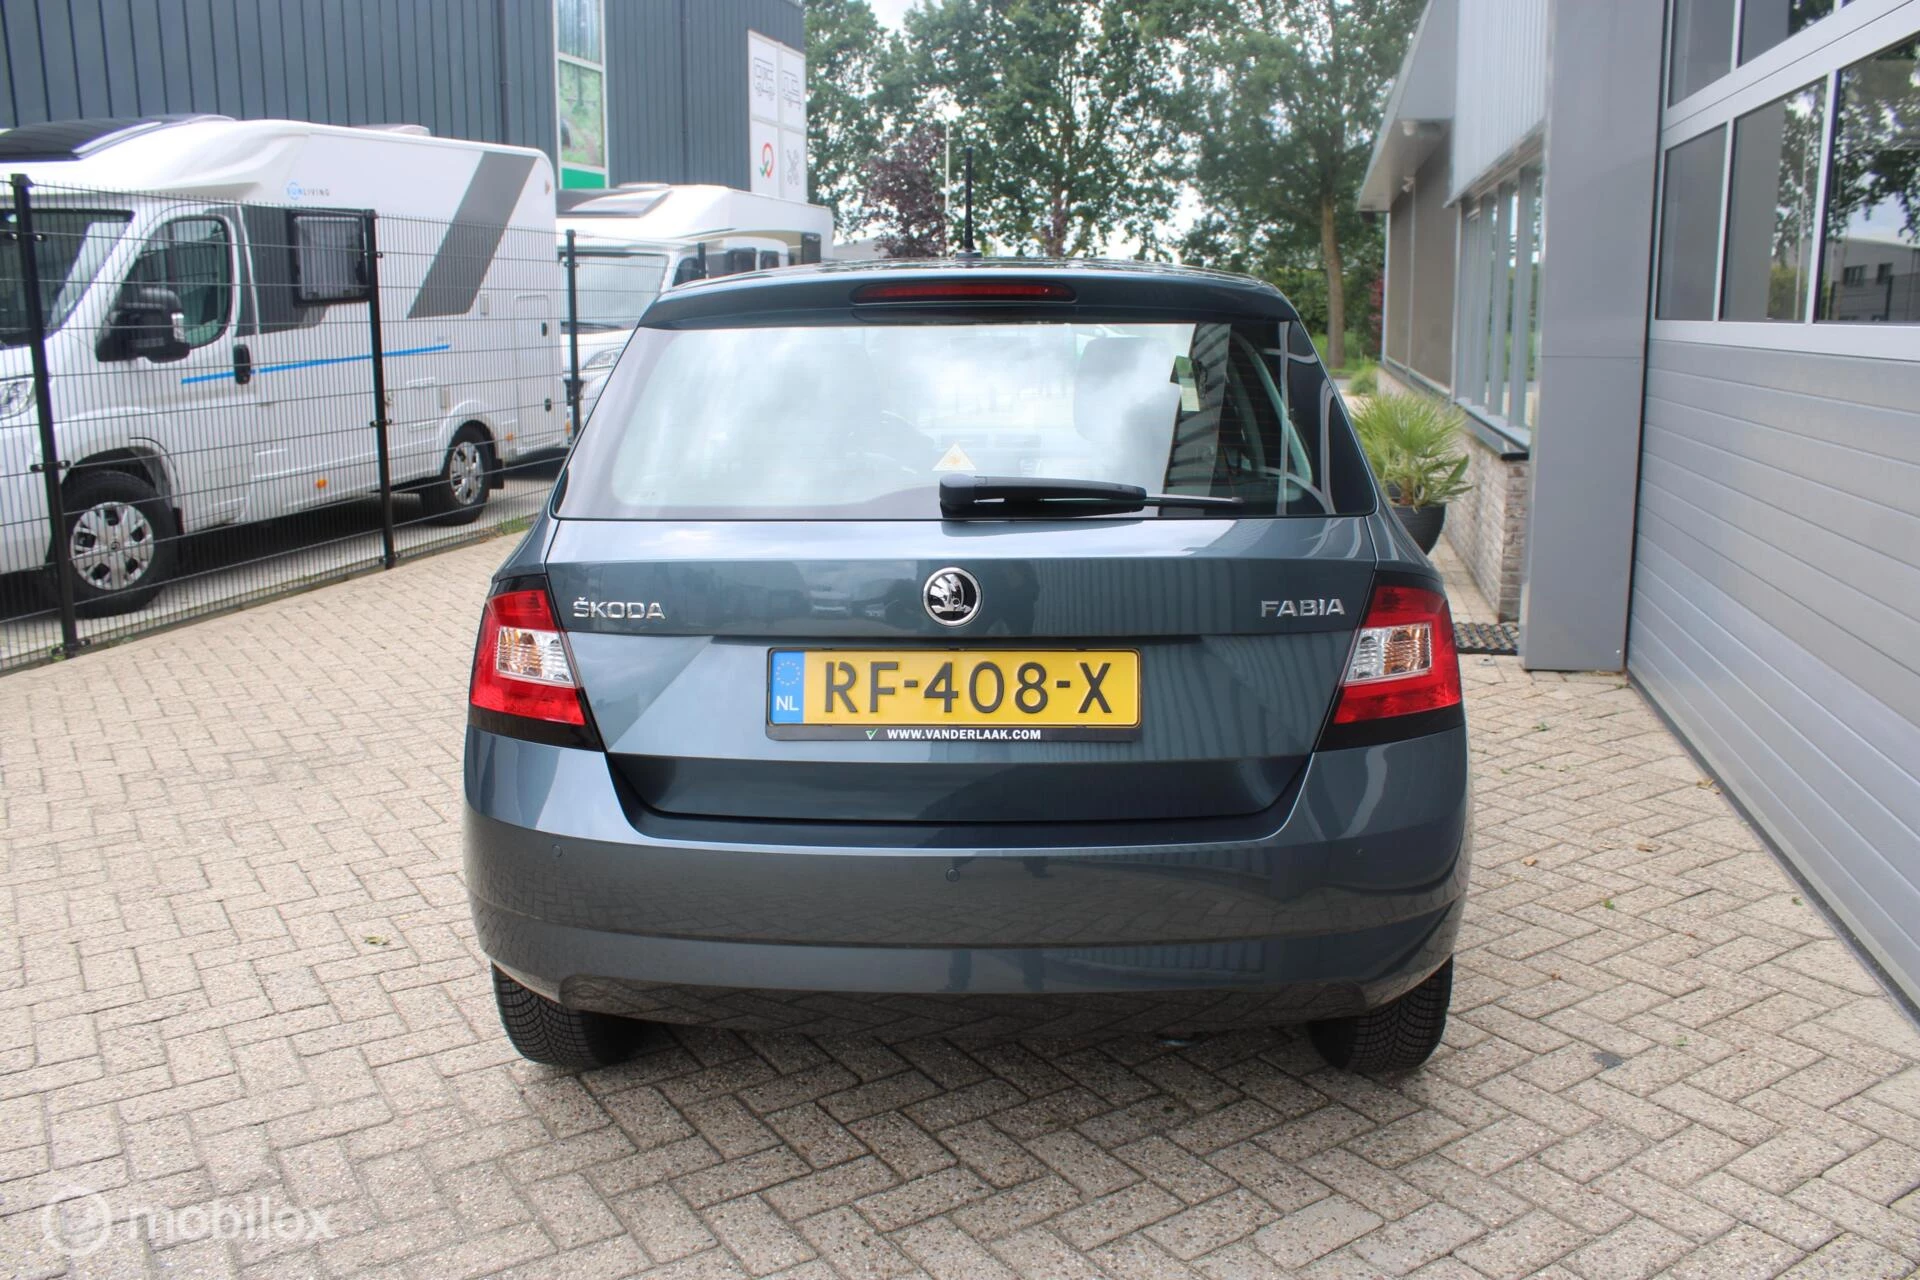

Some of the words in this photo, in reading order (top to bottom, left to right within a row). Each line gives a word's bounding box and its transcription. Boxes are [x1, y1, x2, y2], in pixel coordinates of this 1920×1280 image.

[573, 596, 666, 620] ŠKODA
[1260, 599, 1346, 618] FABIA
[824, 661, 1113, 714] RF-408-X
[776, 695, 800, 711] NL
[887, 728, 1041, 740] WWW.VANDERLAAK.COM
